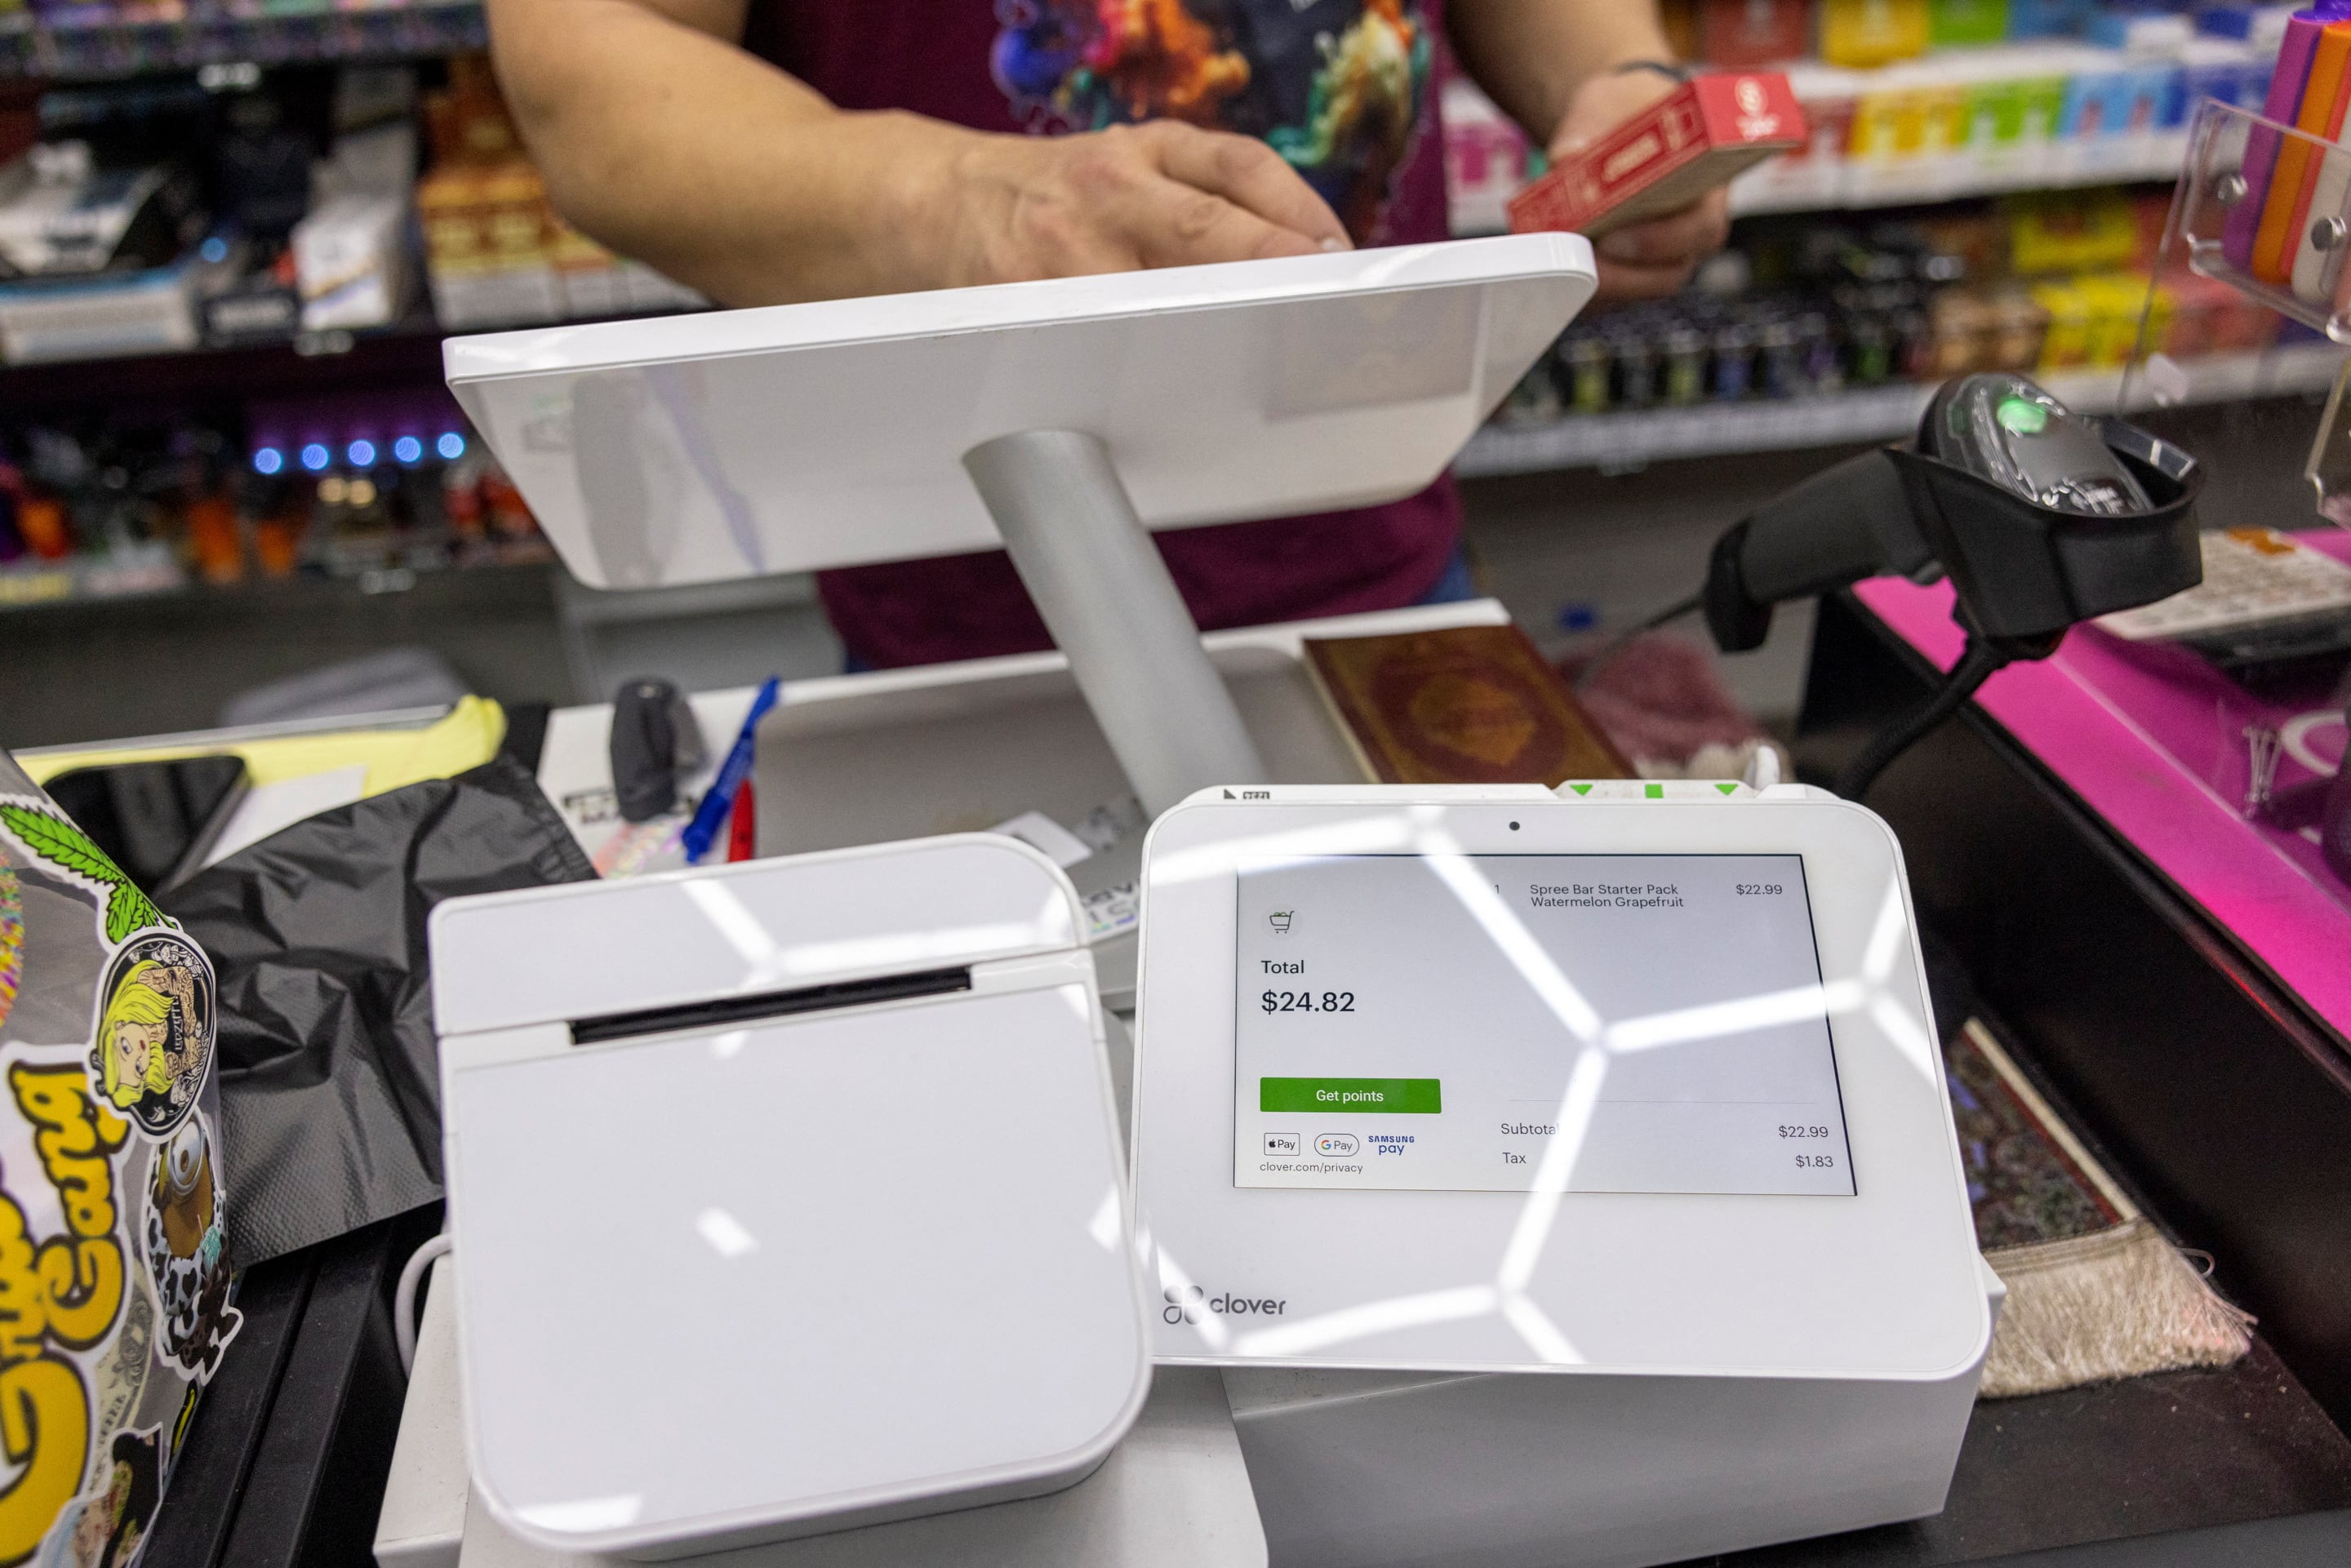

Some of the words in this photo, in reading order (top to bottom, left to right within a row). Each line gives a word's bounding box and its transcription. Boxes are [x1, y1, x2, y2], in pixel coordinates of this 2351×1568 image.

[1494, 885, 1500, 895] 1
[1530, 884, 1569, 897] Spree
[1572, 884, 1594, 895] Bar
[1598, 884, 1643, 895] Starter
[1647, 884, 1678, 895] Pack
[1735, 884, 1783, 896] $22.99
[1531, 896, 1611, 908] Watermelon
[1615, 896, 1684, 909] Grapefruit
[1261, 959, 1304, 974] Total
[1261, 989, 1355, 1015] $24.82
[1316, 1090, 1339, 1101] Get
[1342, 1090, 1384, 1104] points
[1500, 1122, 1560, 1135] Subtotal
[1778, 1125, 1829, 1139] $22.99
[1278, 1139, 1296, 1150] Pay
[1334, 1140, 1353, 1152] Pay
[1368, 1135, 1415, 1144] SAMSUNG
[1379, 1144, 1405, 1156] pay
[1502, 1152, 1527, 1164] Tax
[1795, 1154, 1833, 1168] $1.83
[1260, 1162, 1363, 1175] clover.com/privacy
[1209, 1292, 1286, 1315] clover
